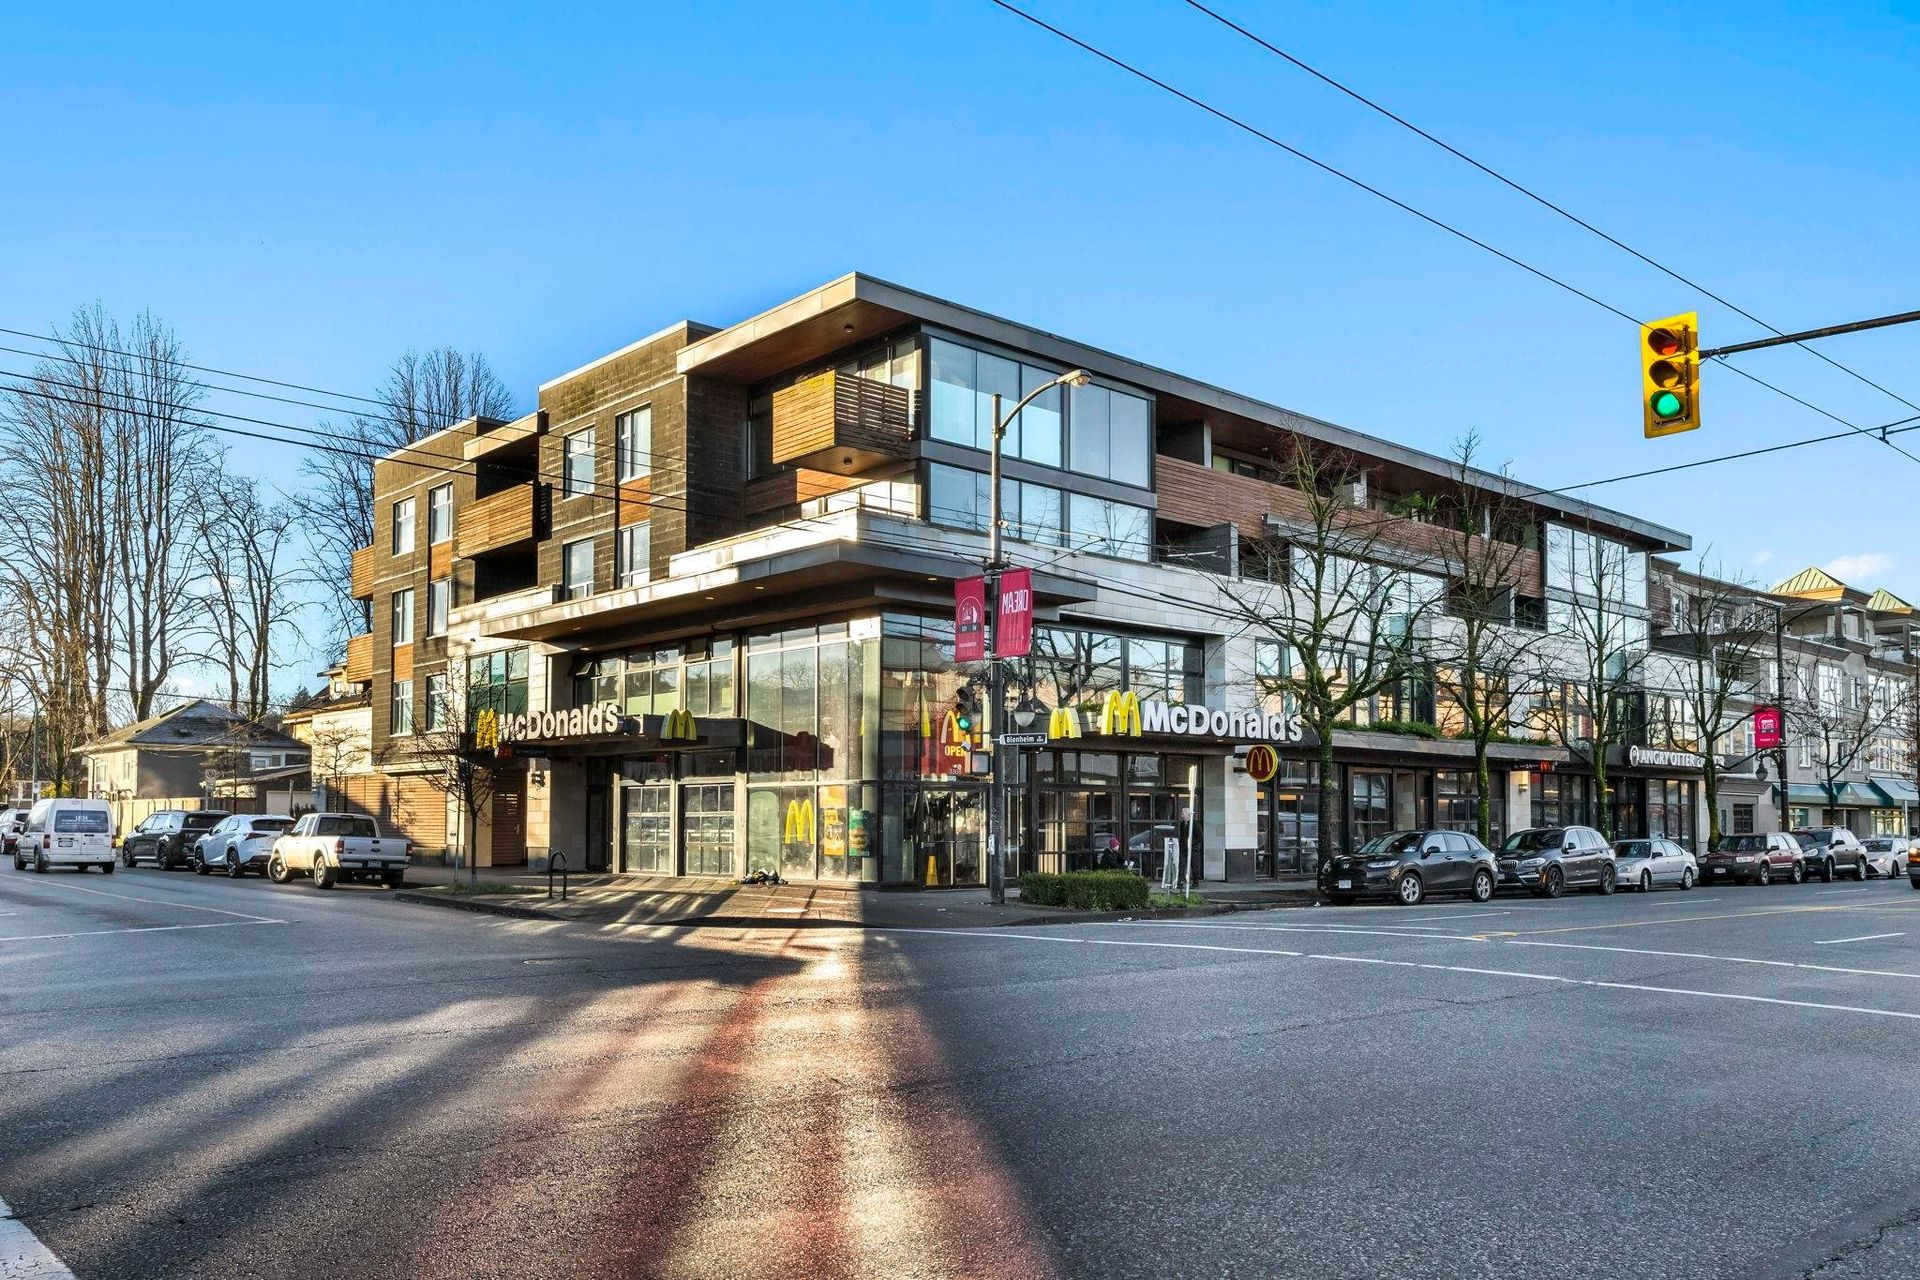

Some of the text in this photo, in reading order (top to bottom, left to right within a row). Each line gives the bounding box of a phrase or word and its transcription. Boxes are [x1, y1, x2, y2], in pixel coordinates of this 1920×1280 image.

[498, 703, 618, 741] McDonald's
[1143, 701, 1302, 742] McDonald's
[1006, 735, 1035, 743] Blenheim
[1640, 750, 1669, 765] ANGRY
[1671, 753, 1696, 767] OTTER
